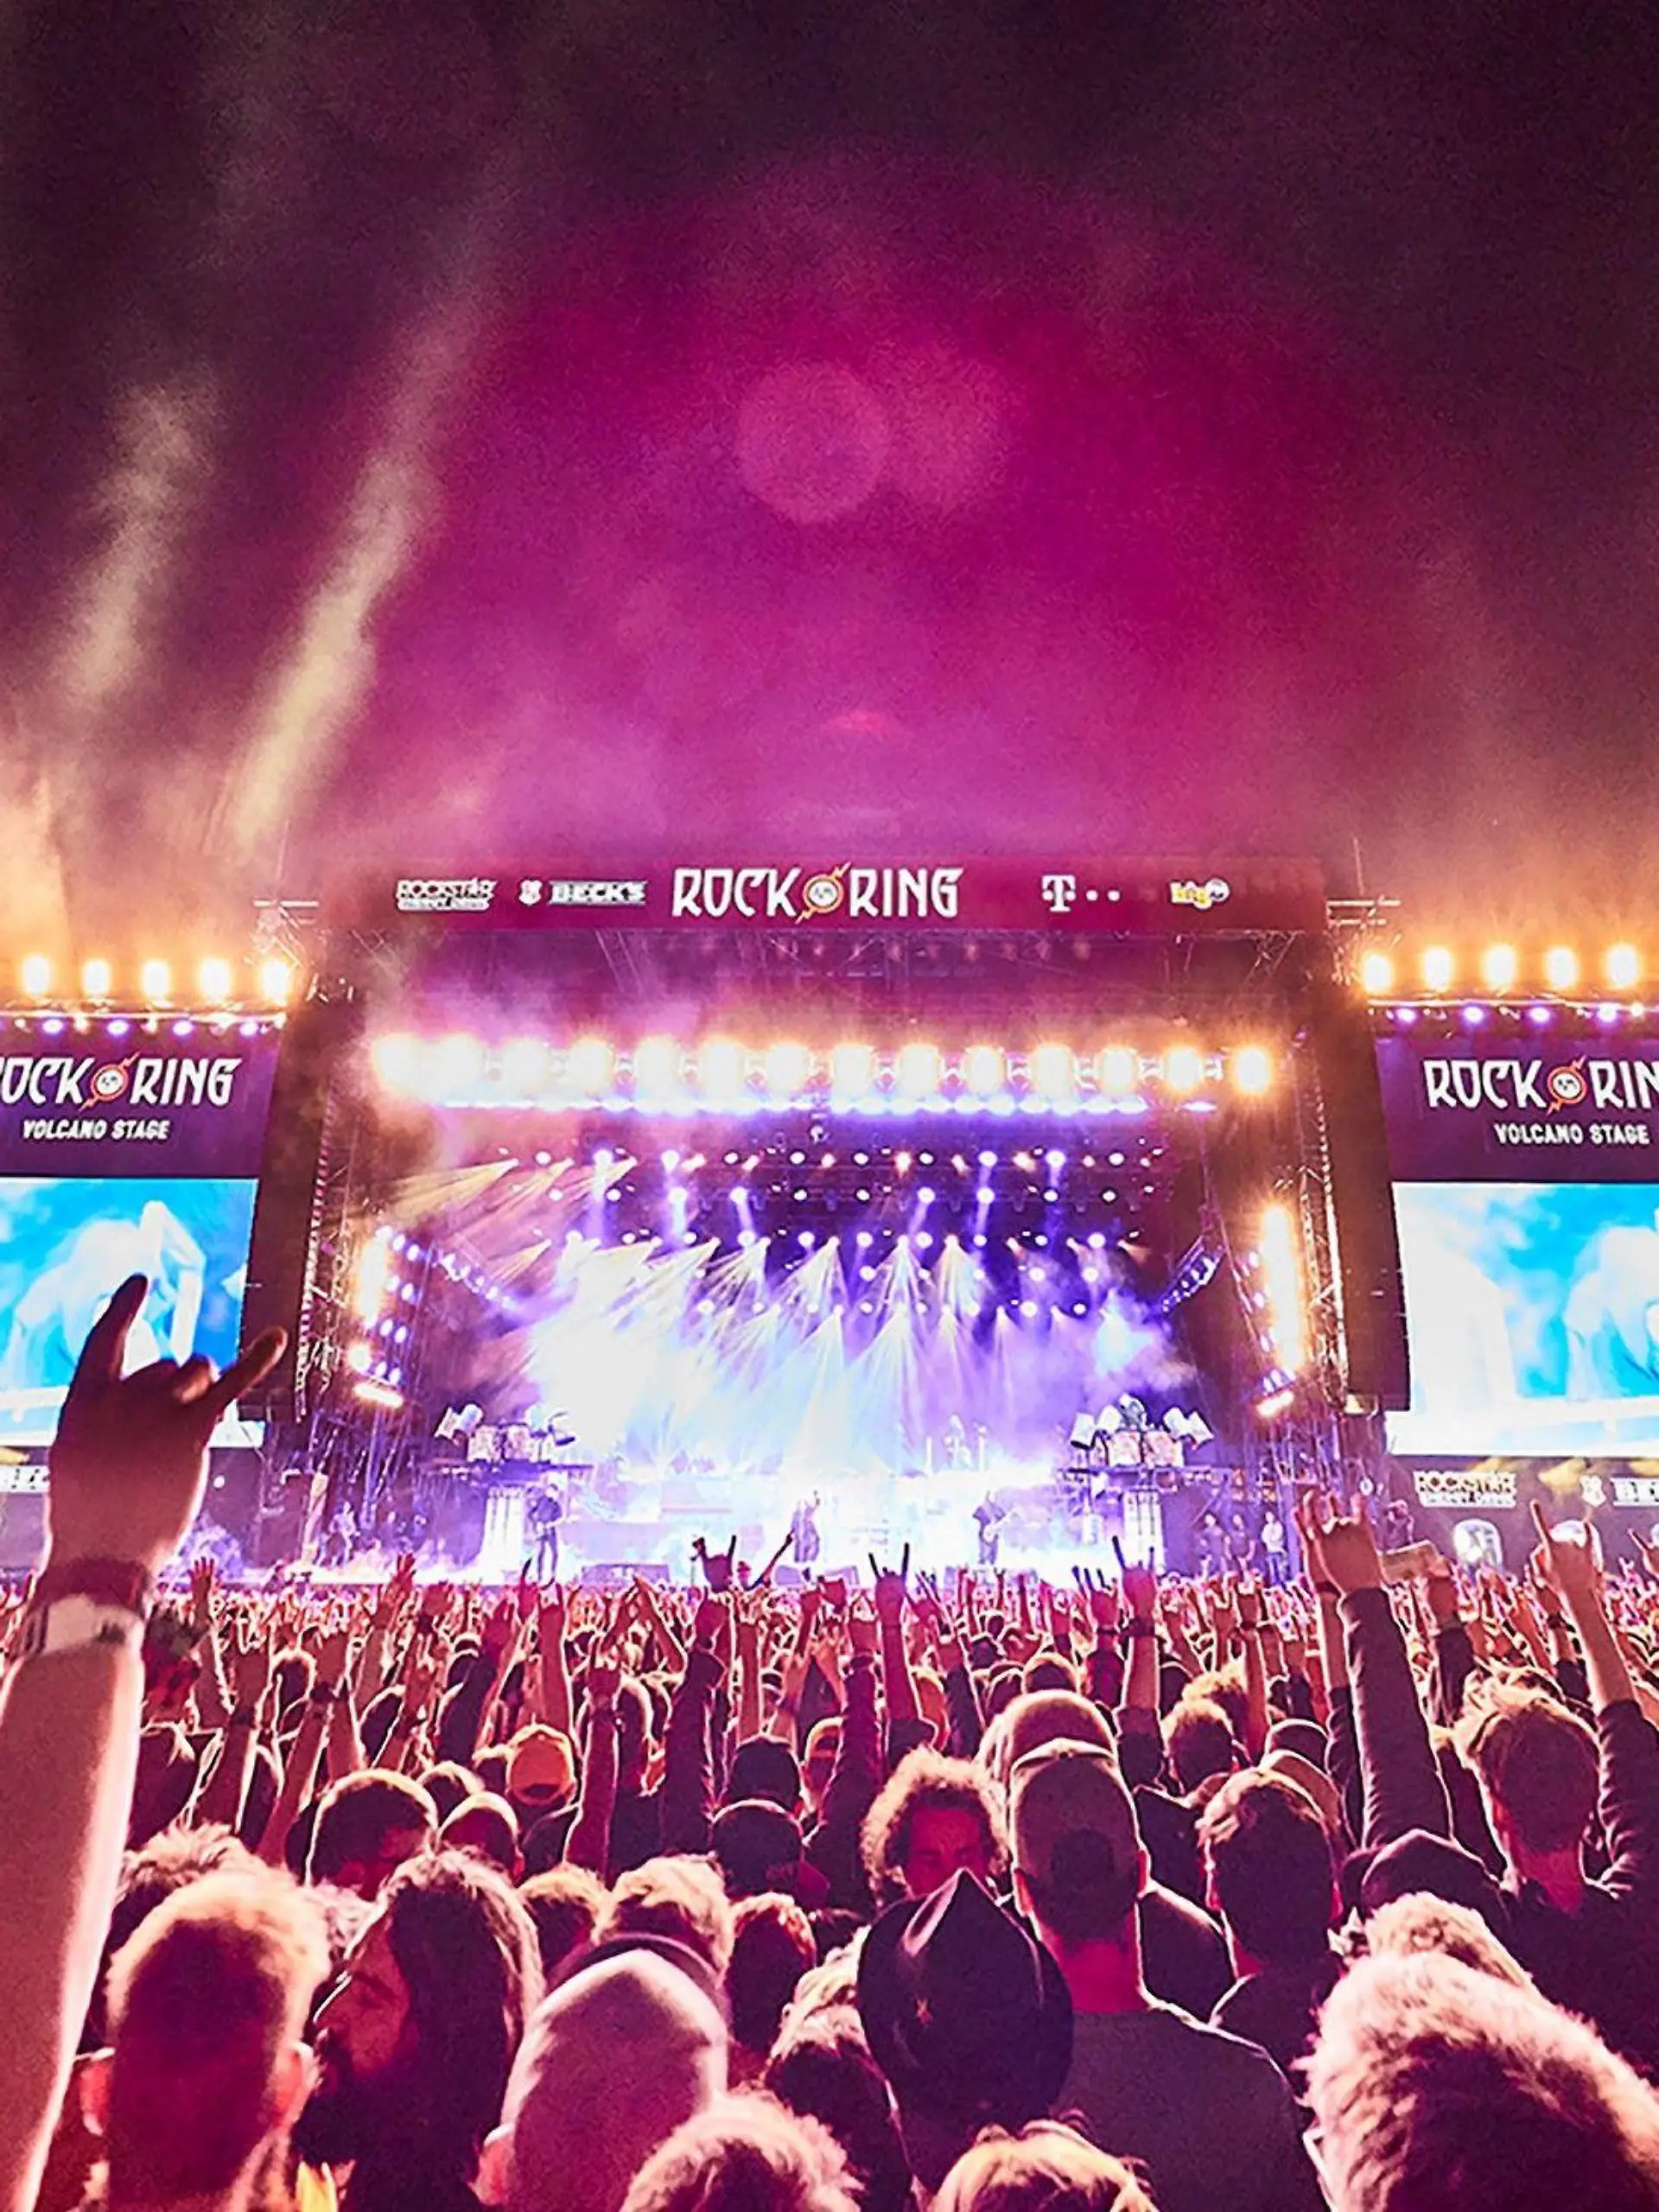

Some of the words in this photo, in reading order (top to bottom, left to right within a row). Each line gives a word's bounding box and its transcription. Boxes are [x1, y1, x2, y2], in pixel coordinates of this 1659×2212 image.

[671, 868, 801, 918] ROCK
[849, 868, 963, 918] RING
[0, 1057, 95, 1104] OCK
[130, 1057, 243, 1107] RING
[1423, 1059, 1548, 1109] ROCK
[22, 1119, 106, 1140] VOLCANO
[111, 1119, 170, 1140] STAGE
[1493, 1123, 1584, 1145] VOLCANO
[1589, 1123, 1650, 1145] STAGE
